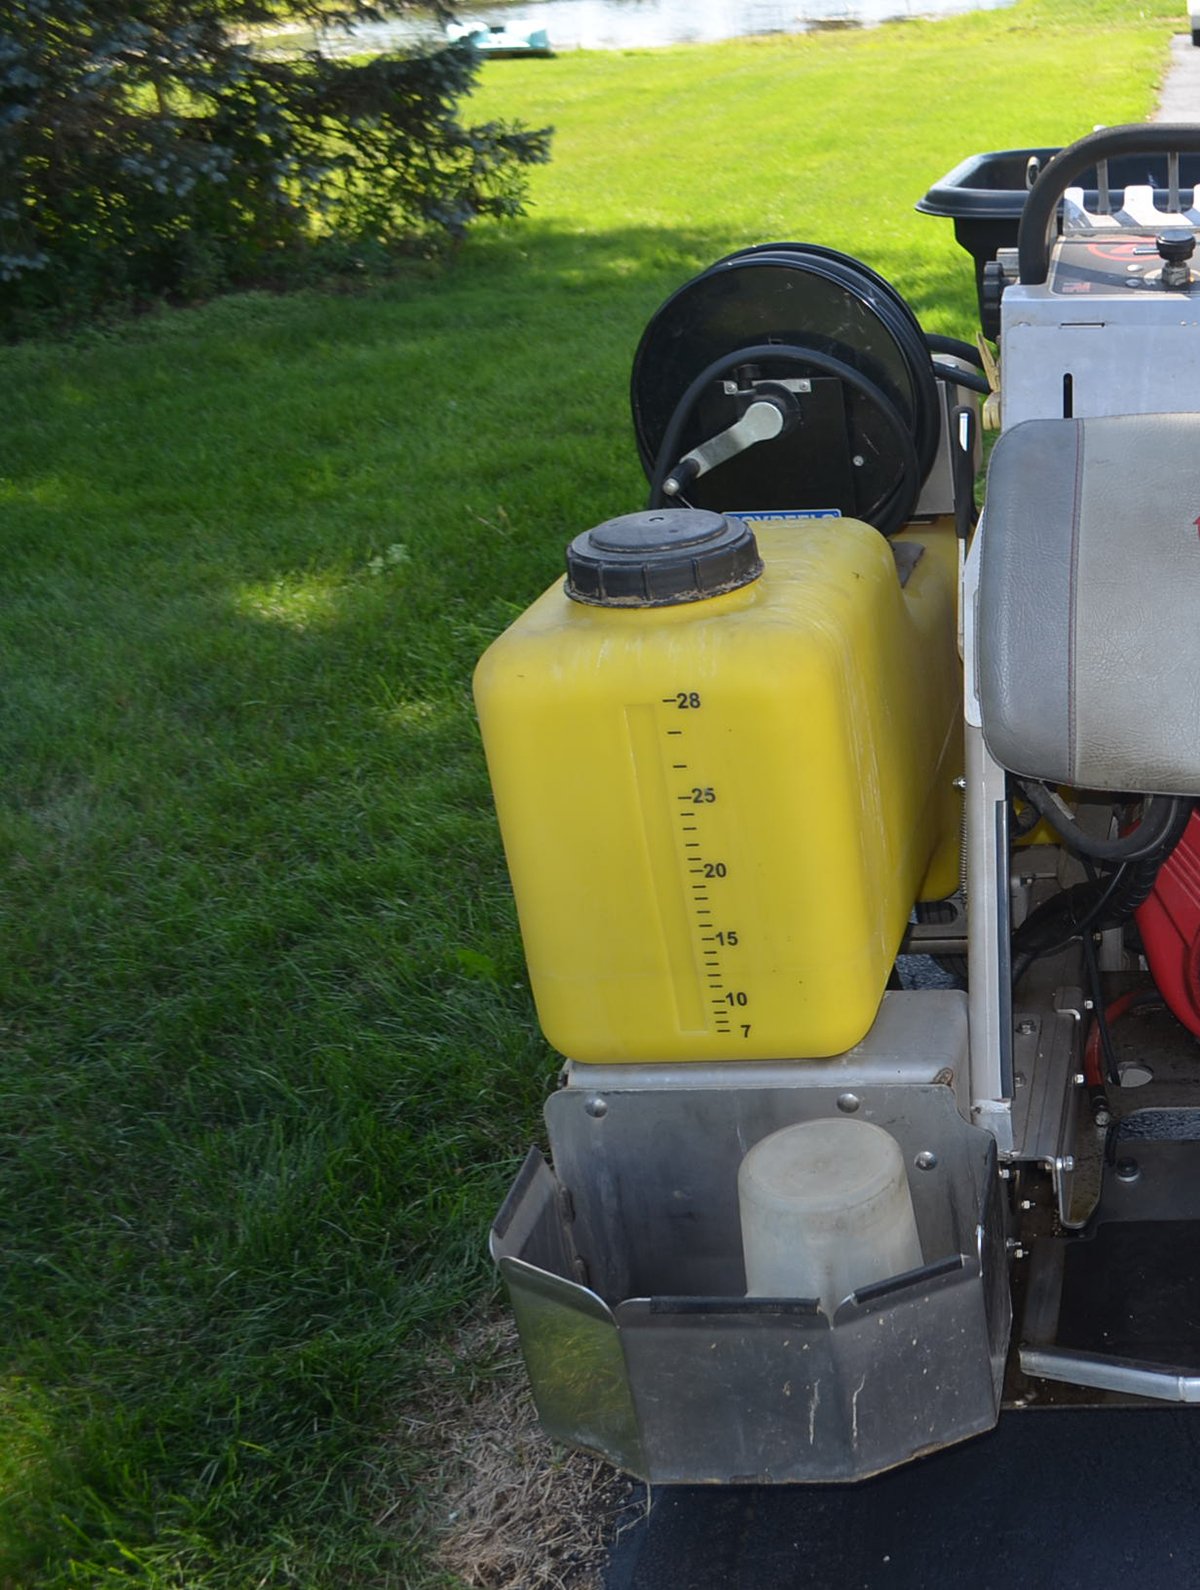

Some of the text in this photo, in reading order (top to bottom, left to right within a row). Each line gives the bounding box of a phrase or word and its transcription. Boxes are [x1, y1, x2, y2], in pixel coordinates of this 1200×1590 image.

[676, 691, 702, 710] 28
[691, 787, 717, 804] 25
[703, 862, 727, 879] 20
[715, 930, 739, 947] 15
[725, 991, 748, 1007] 10
[740, 1024, 752, 1039] 7
